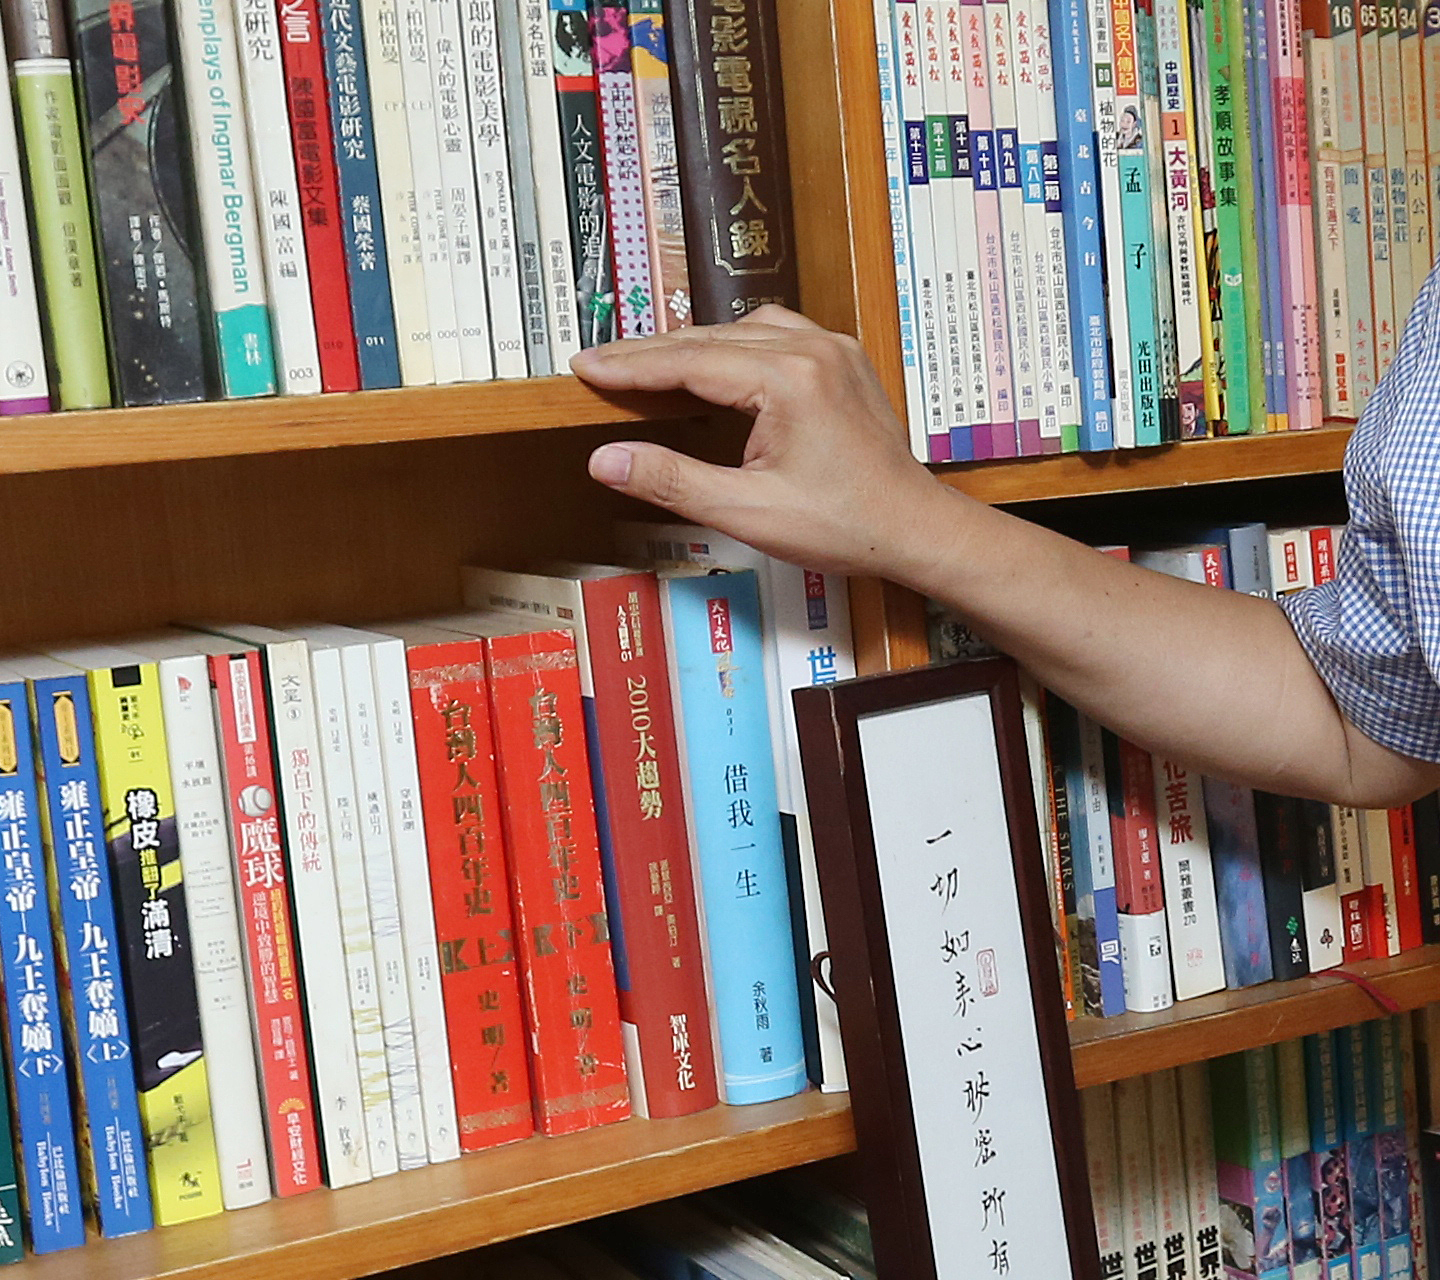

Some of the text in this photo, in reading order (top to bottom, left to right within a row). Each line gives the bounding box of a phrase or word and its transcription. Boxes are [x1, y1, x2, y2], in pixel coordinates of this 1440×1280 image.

[1331, 5, 1354, 30] 16
[1359, 4, 1378, 28] 65
[1378, 5, 1399, 29] 51
[1398, 6, 1419, 30] 34
[209, 85, 230, 116] of
[1164, 59, 1190, 213] 中國歷史 大黃河
[210, 112, 237, 191] Ingmar
[1025, 148, 1041, 199] 第八期
[1212, 82, 1239, 209] 孝順故事集
[222, 192, 250, 294] Bergman
[1123, 165, 1148, 271] 孟子
[1408, 168, 1428, 244] 小公子
[365, 335, 386, 347] 011
[626, 675, 663, 822] 2010大趨勢
[290, 747, 323, 874] 獨白下的傳統
[441, 699, 494, 918] 台灣人四百年史
[239, 820, 286, 888] 魔球
[1060, 831, 1074, 893] STARS
[723, 764, 762, 899] 借我一生
[751, 980, 771, 1031] 余秋雨
[669, 1013, 696, 1092] 智庫文化
